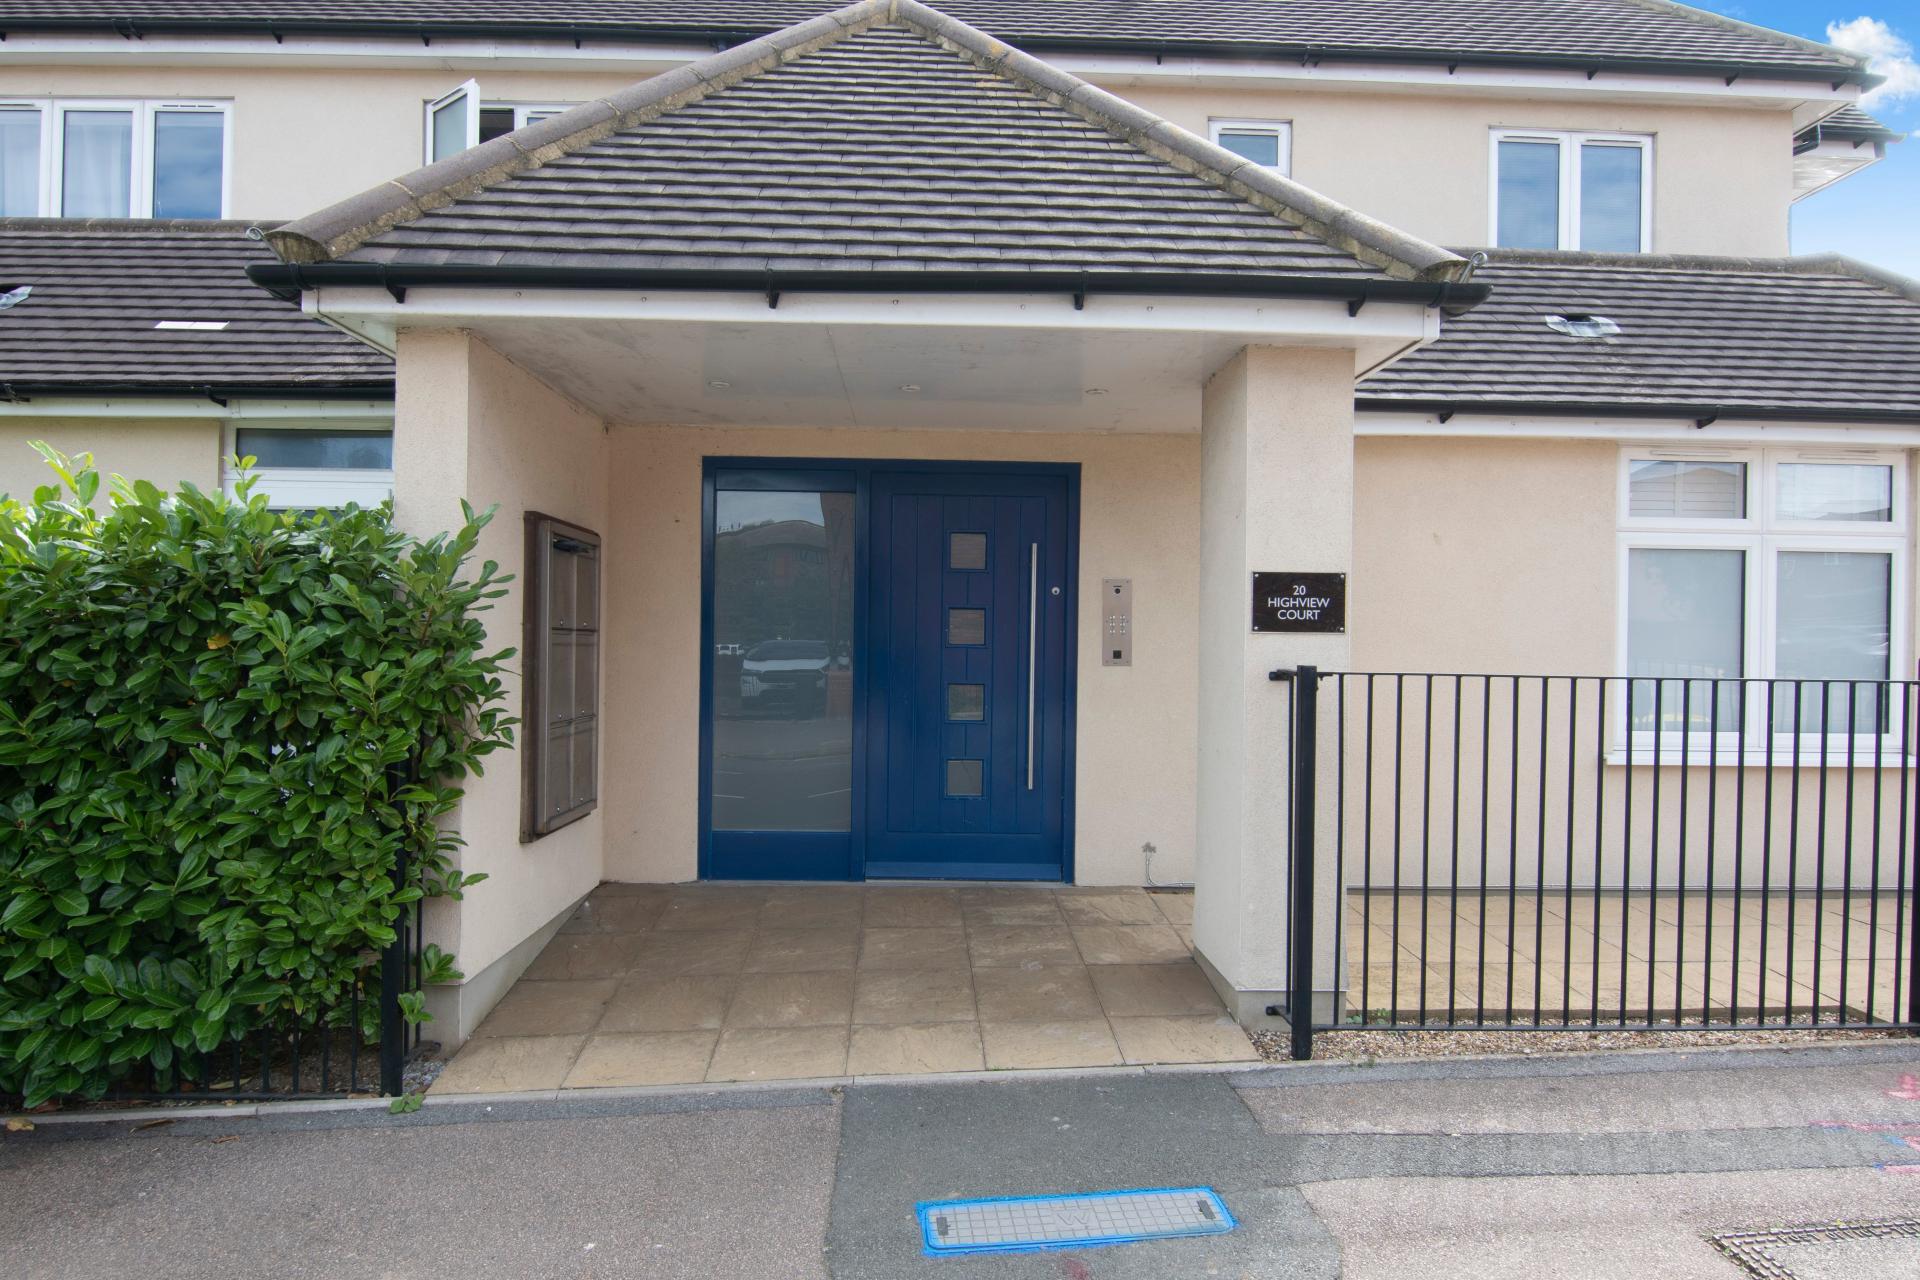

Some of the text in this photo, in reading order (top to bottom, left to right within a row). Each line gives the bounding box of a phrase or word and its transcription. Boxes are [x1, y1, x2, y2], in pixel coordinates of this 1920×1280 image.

[1293, 585, 1306, 596] 20
[1267, 597, 1330, 608] HIGHVIEW
[1277, 609, 1321, 620] COURT
